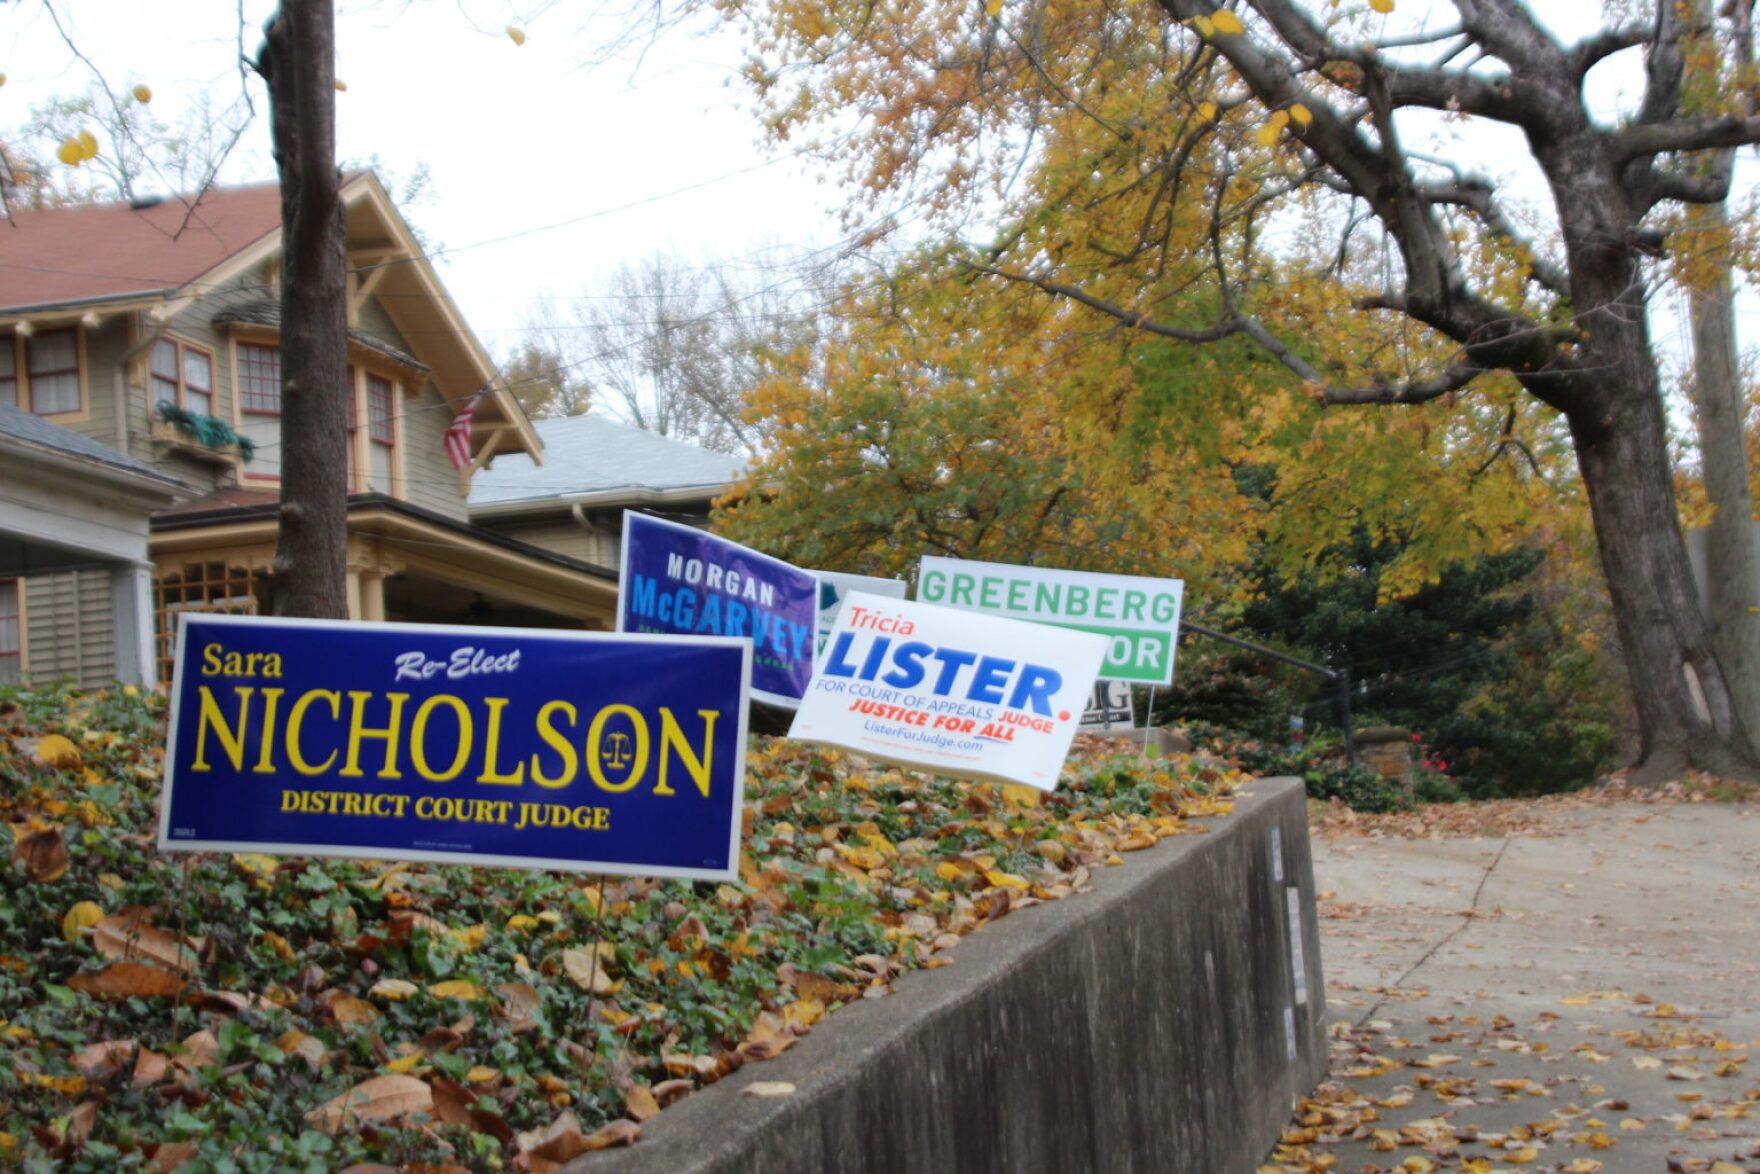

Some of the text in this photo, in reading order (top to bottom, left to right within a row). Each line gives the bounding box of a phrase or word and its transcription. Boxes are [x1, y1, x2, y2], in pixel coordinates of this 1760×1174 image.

[667, 552, 773, 607] MORGAN
[922, 570, 1176, 624] GREENBERG
[632, 574, 809, 661] McGARVEY
[850, 606, 915, 636] Tricia
[202, 643, 283, 678] Sara
[395, 646, 521, 682] Re-Elect
[1106, 634, 1163, 668] OR
[815, 679, 1055, 734] FOR COURT OF APPEALS JUDGE
[848, 698, 1015, 741] JUSTICE FOR ALL
[190, 685, 720, 799] NICHOLSON
[863, 719, 984, 752] ListerForJudge.com
[281, 789, 611, 830] DISTRICT COURT JUDGE
